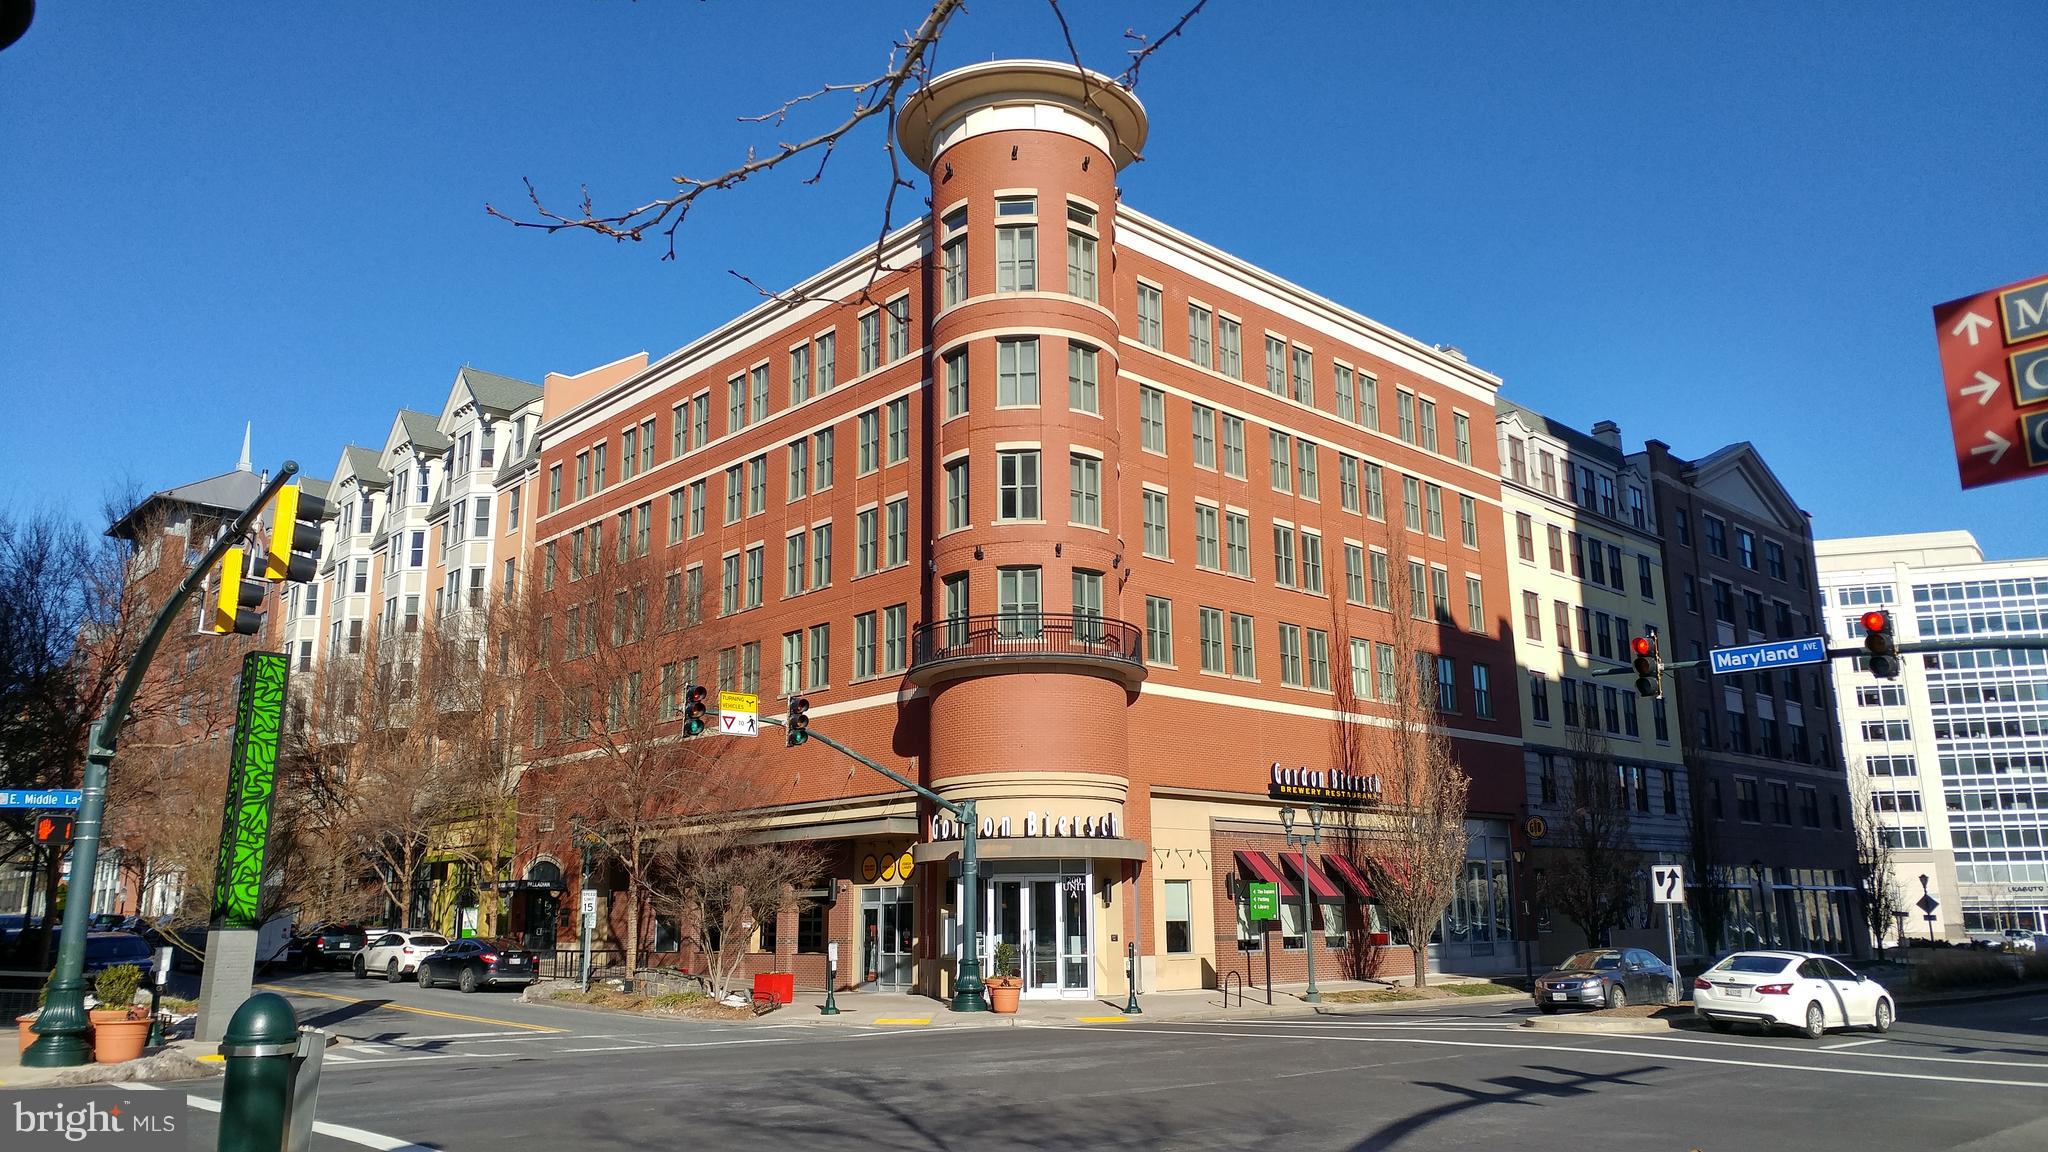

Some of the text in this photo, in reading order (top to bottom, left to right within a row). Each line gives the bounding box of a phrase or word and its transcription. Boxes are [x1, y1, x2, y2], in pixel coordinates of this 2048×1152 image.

[1717, 642, 1818, 667] Maryland AVE
[1273, 762, 1325, 788] Gordon
[1280, 785, 1321, 796] BREWERY
[10, 794, 20, 804] E.
[25, 794, 58, 804] Middle
[1026, 811, 1120, 838] Biersch
[1063, 883, 1086, 891] UNIT
[1070, 890, 1078, 899] A
[584, 903, 594, 912] 15
